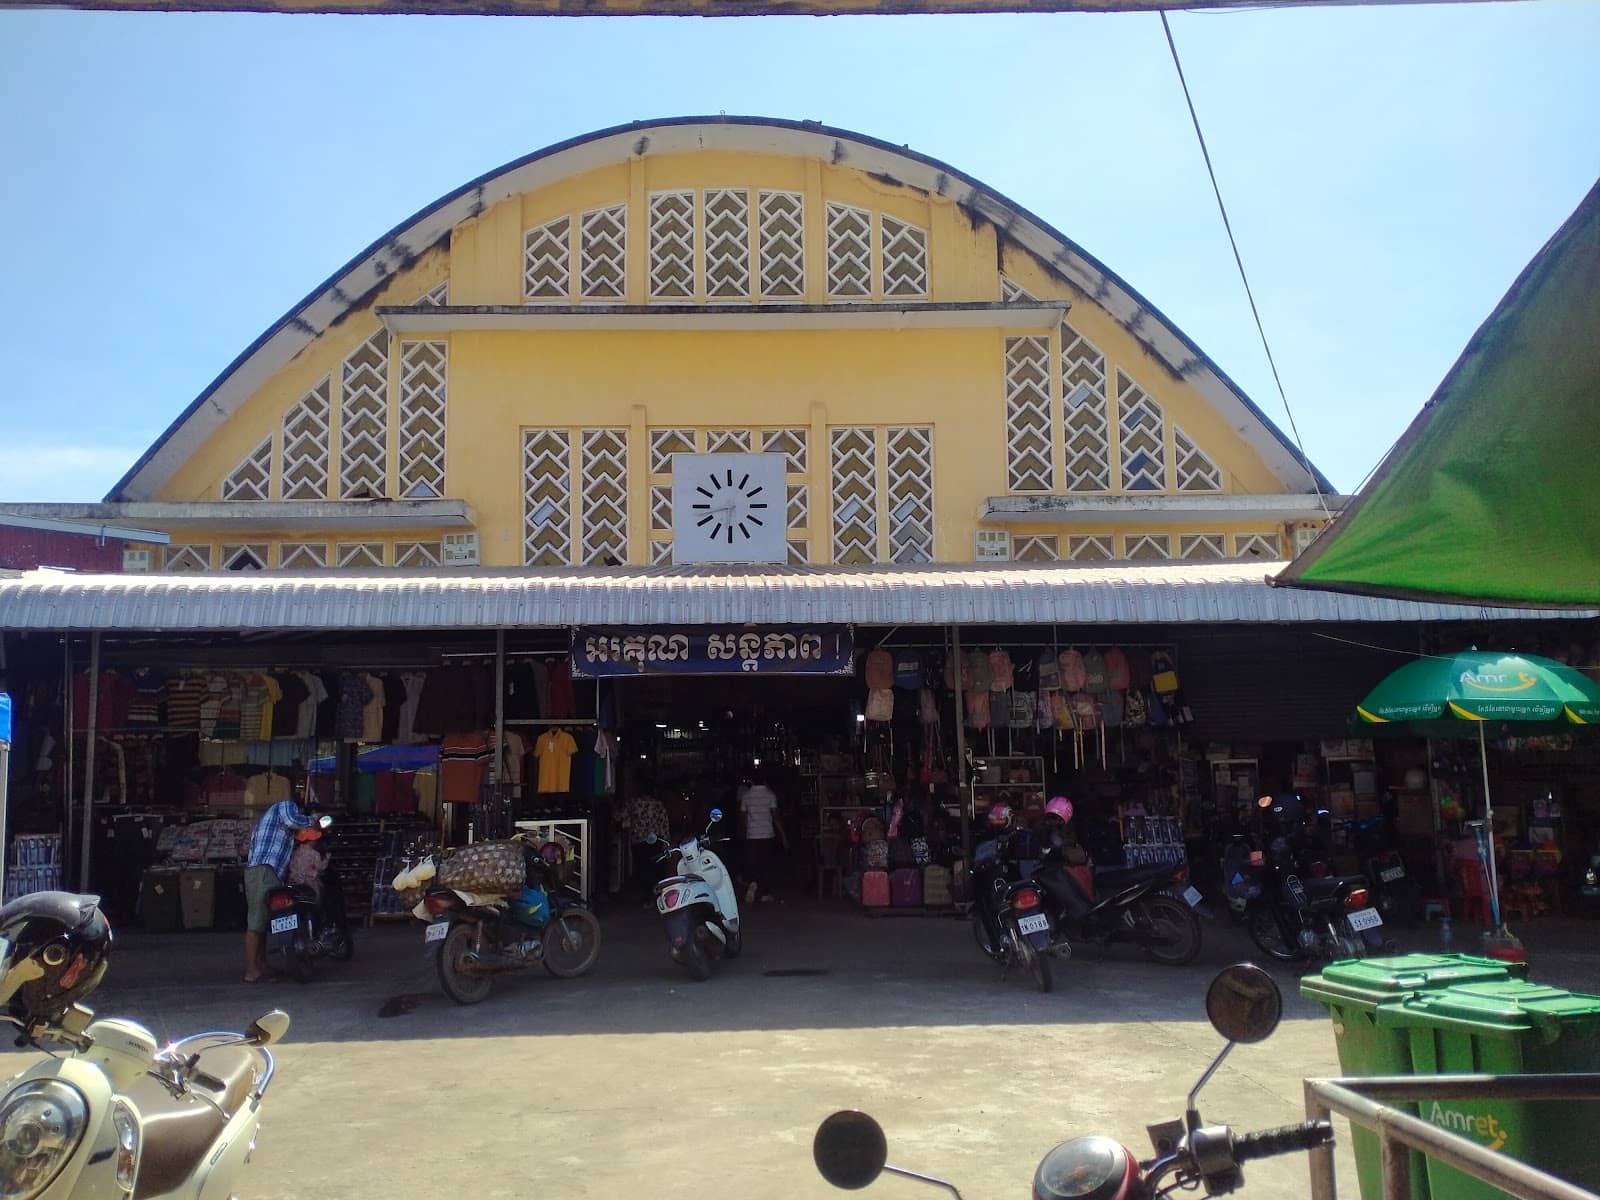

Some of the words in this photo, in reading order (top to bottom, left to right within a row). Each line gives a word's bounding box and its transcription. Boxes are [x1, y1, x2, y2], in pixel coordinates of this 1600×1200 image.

[586, 633, 689, 671] អរគុណ
[1460, 669, 1531, 684] Amrt
[1430, 1101, 1499, 1138] Amret
